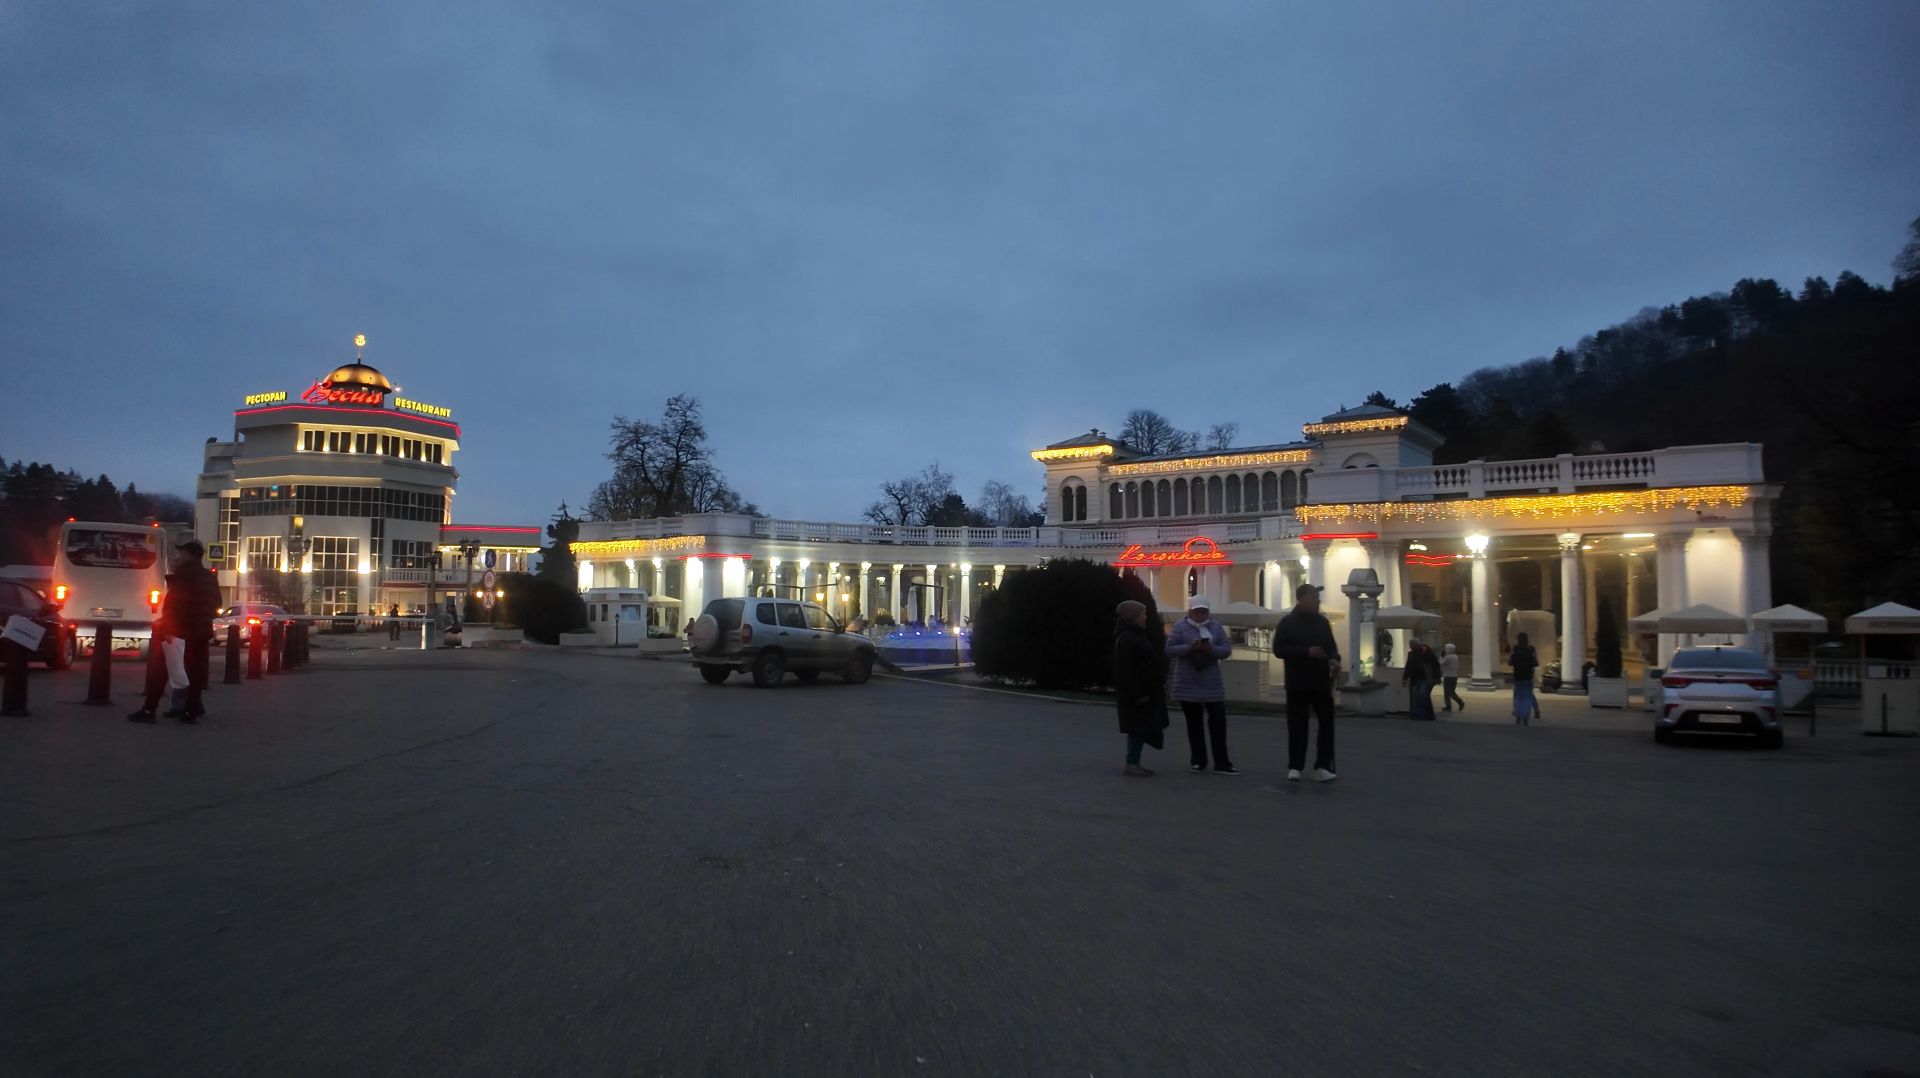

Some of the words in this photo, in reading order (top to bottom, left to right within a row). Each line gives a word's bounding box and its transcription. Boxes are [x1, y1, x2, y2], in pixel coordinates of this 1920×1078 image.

[246, 391, 286, 405] РЕСТОРАН
[301, 379, 383, 404] Весна
[395, 397, 452, 417] RESTAURANT
